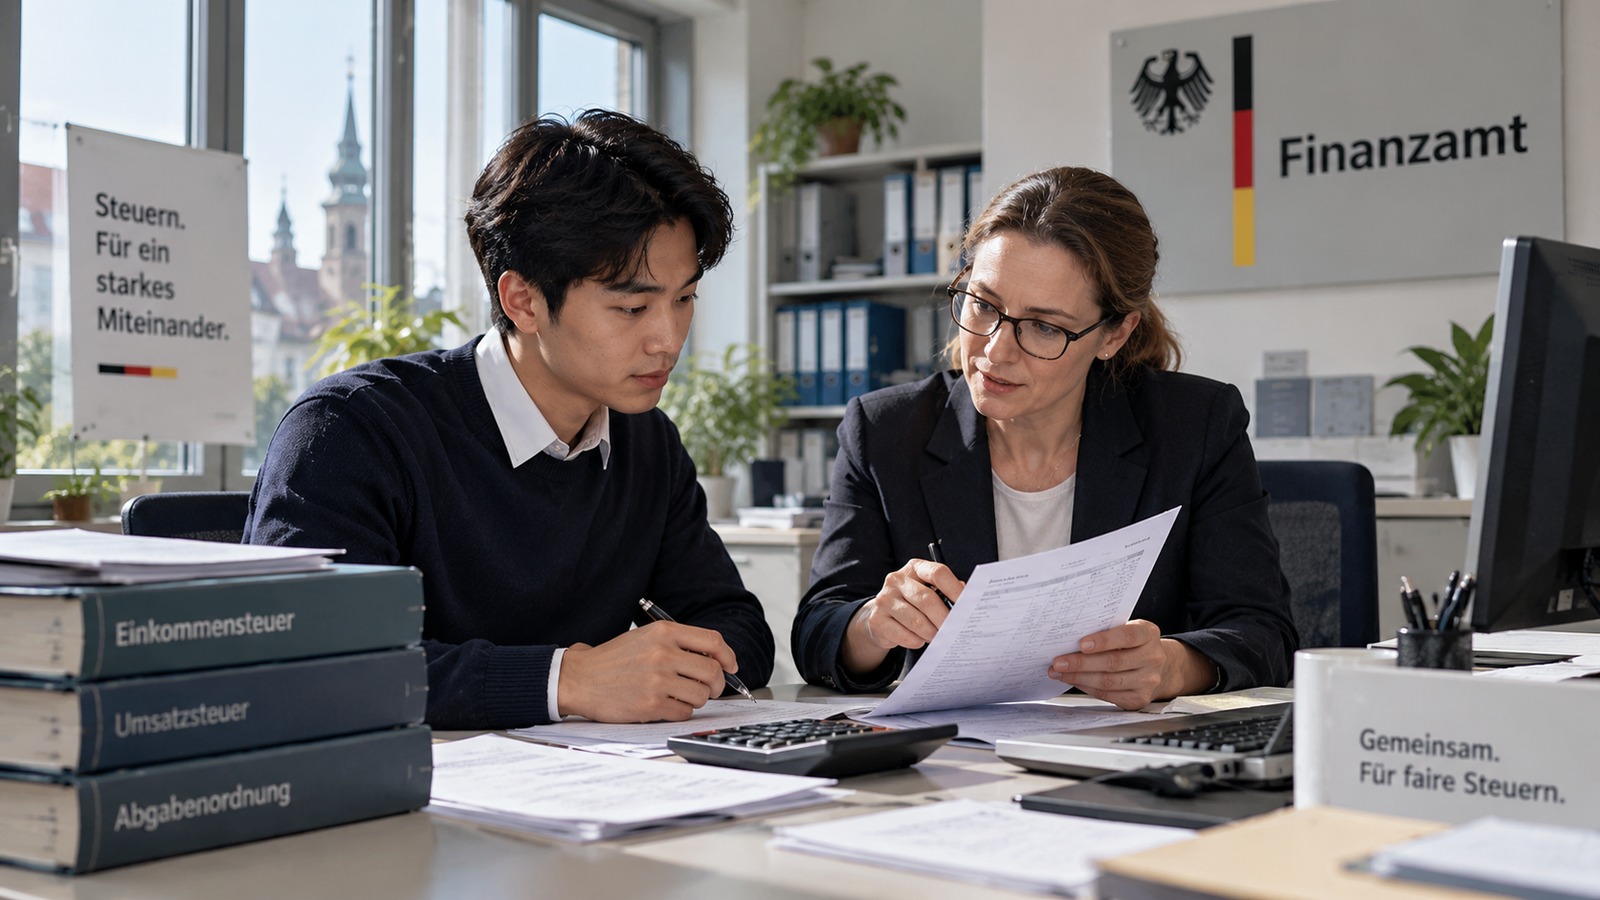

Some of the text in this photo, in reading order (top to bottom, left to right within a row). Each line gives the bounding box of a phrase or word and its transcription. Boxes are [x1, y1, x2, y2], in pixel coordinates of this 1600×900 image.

[1280, 114, 1528, 178] Finanzamt
[95, 192, 186, 230] Steuern.
[96, 231, 170, 263] Für ein
[96, 271, 175, 300] starkes
[97, 305, 229, 341] Miteinander.
[115, 612, 296, 647] Einkommensteuer
[114, 701, 250, 738] Umsatzsteuer
[1359, 728, 1500, 763] Gemeinsam.
[1359, 761, 1566, 804] Für faire Steuern.
[114, 782, 291, 832] Abgabenordnung
